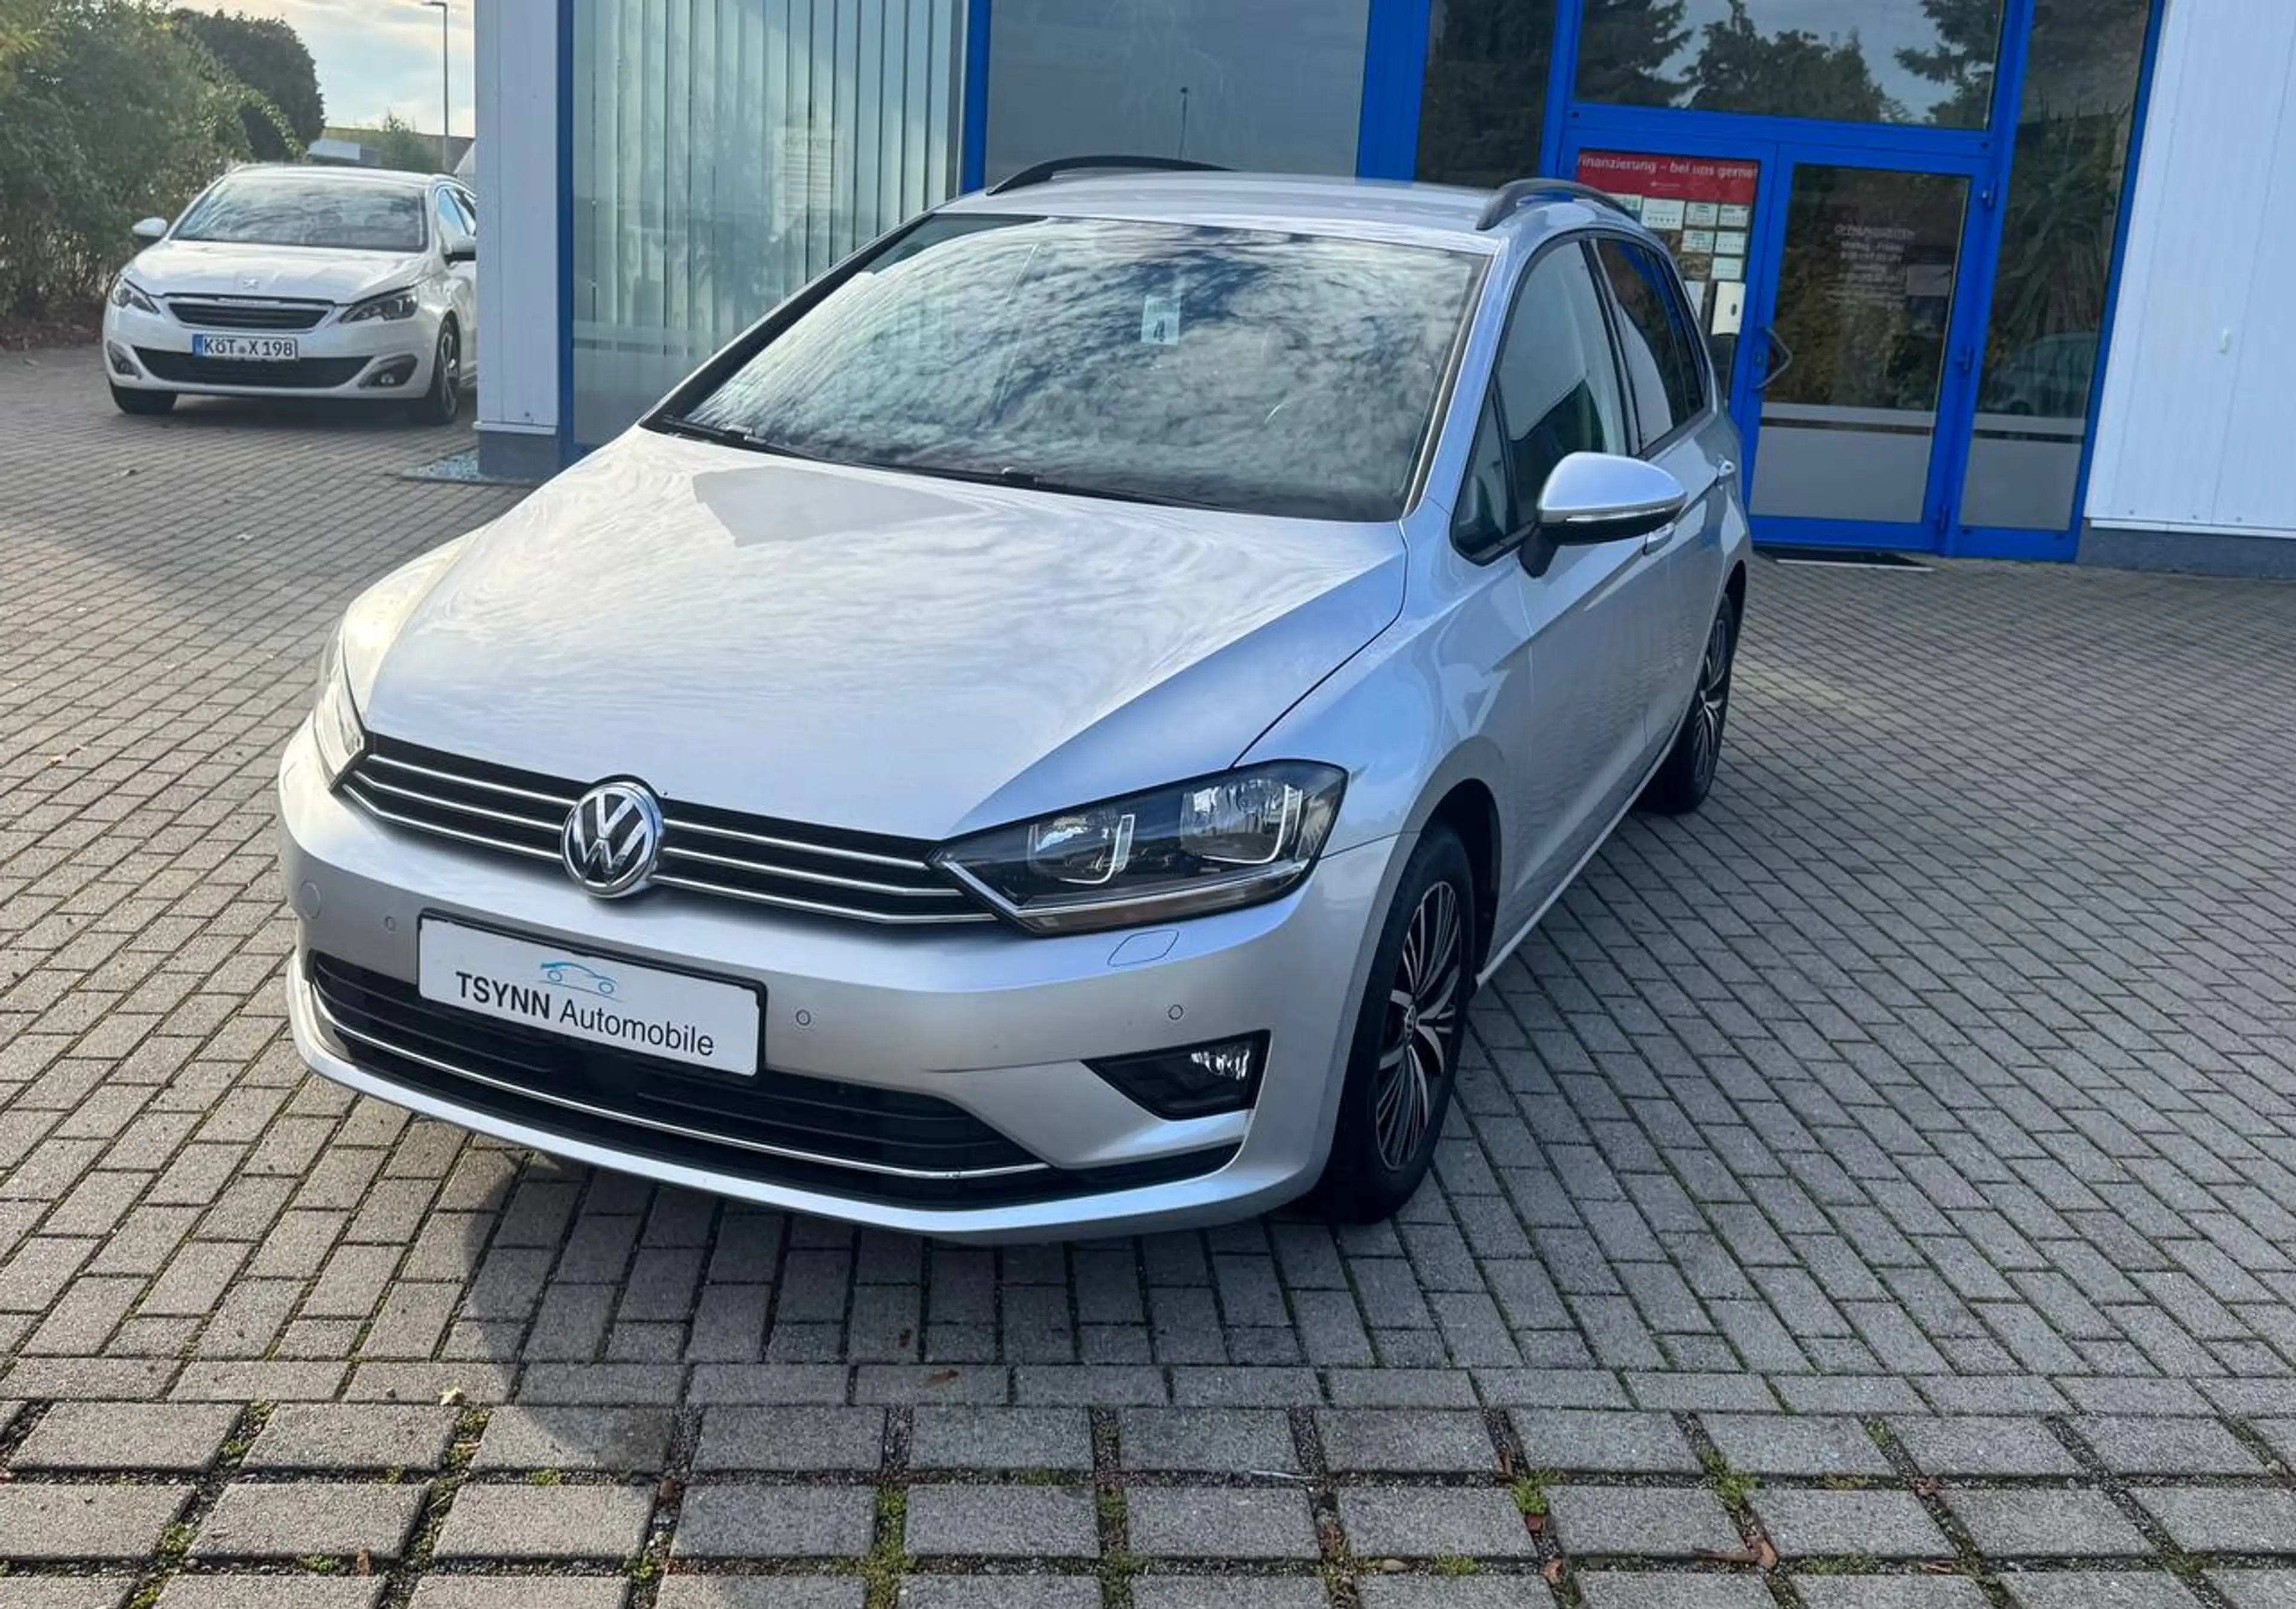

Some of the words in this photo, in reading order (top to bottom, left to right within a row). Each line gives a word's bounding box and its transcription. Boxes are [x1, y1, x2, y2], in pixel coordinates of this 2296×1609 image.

[204, 338, 236, 355] KÖT
[249, 340, 258, 355] X
[262, 341, 293, 356] 198
[456, 971, 550, 1020] TSYNN
[560, 999, 714, 1057] Automobile
